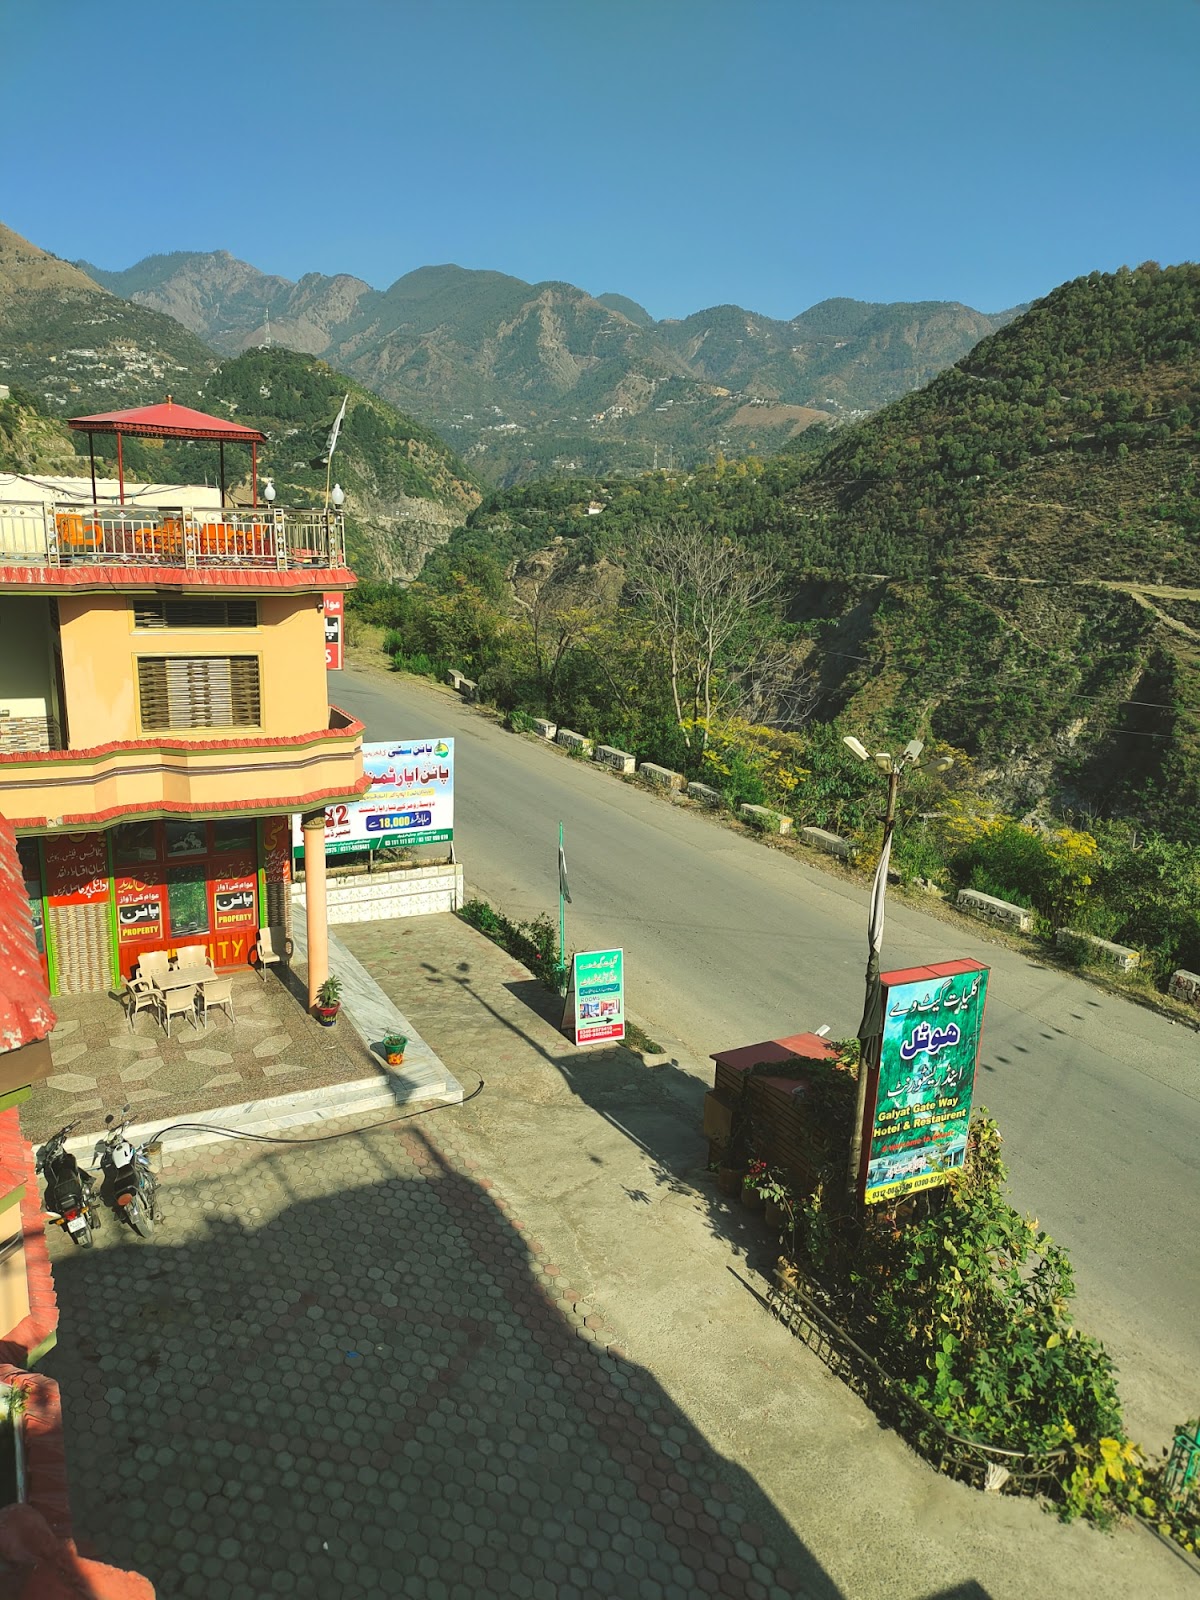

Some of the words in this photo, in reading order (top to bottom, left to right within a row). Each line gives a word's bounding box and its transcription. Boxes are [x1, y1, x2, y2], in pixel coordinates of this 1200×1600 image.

[379, 815, 410, 828] 18,000
[218, 913, 252, 924] PROPERTY
[122, 926, 159, 937] PROPERTY
[878, 1105, 911, 1121] Galyat
[913, 1101, 936, 1113] Gate
[938, 1097, 959, 1108] Way
[873, 1122, 901, 1137] Hotel
[902, 1121, 911, 1130] &
[913, 1108, 967, 1128] Restaurent
